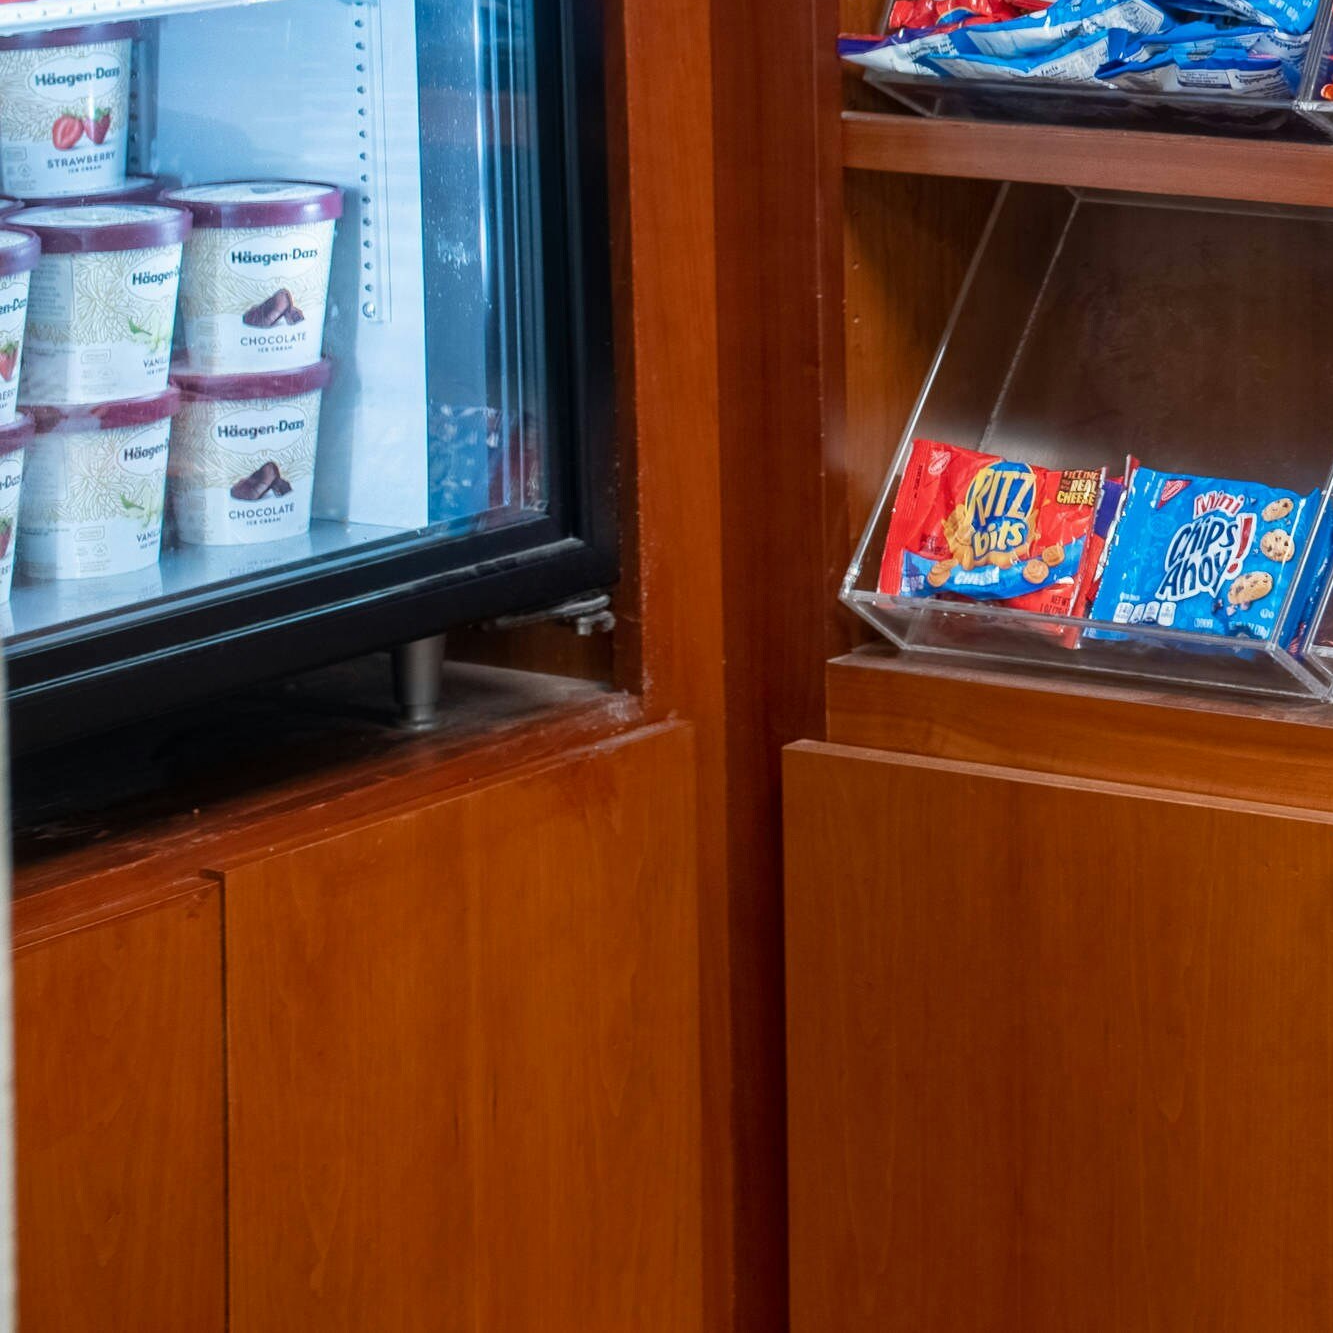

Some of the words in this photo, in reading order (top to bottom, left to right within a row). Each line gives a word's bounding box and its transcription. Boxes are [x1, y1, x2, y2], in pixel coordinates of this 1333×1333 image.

[47, 151, 116, 169] STRAWBERRY
[241, 332, 307, 347] CHOCOLATE
[1071, 479, 1098, 494] REAL
[967, 467, 1037, 526] RITZ
[1057, 491, 1095, 505] CHEESE
[1194, 492, 1244, 516] Mini
[229, 503, 295, 520] CHOCOLATE
[974, 519, 1027, 559] bits
[1167, 517, 1236, 560] Chips
